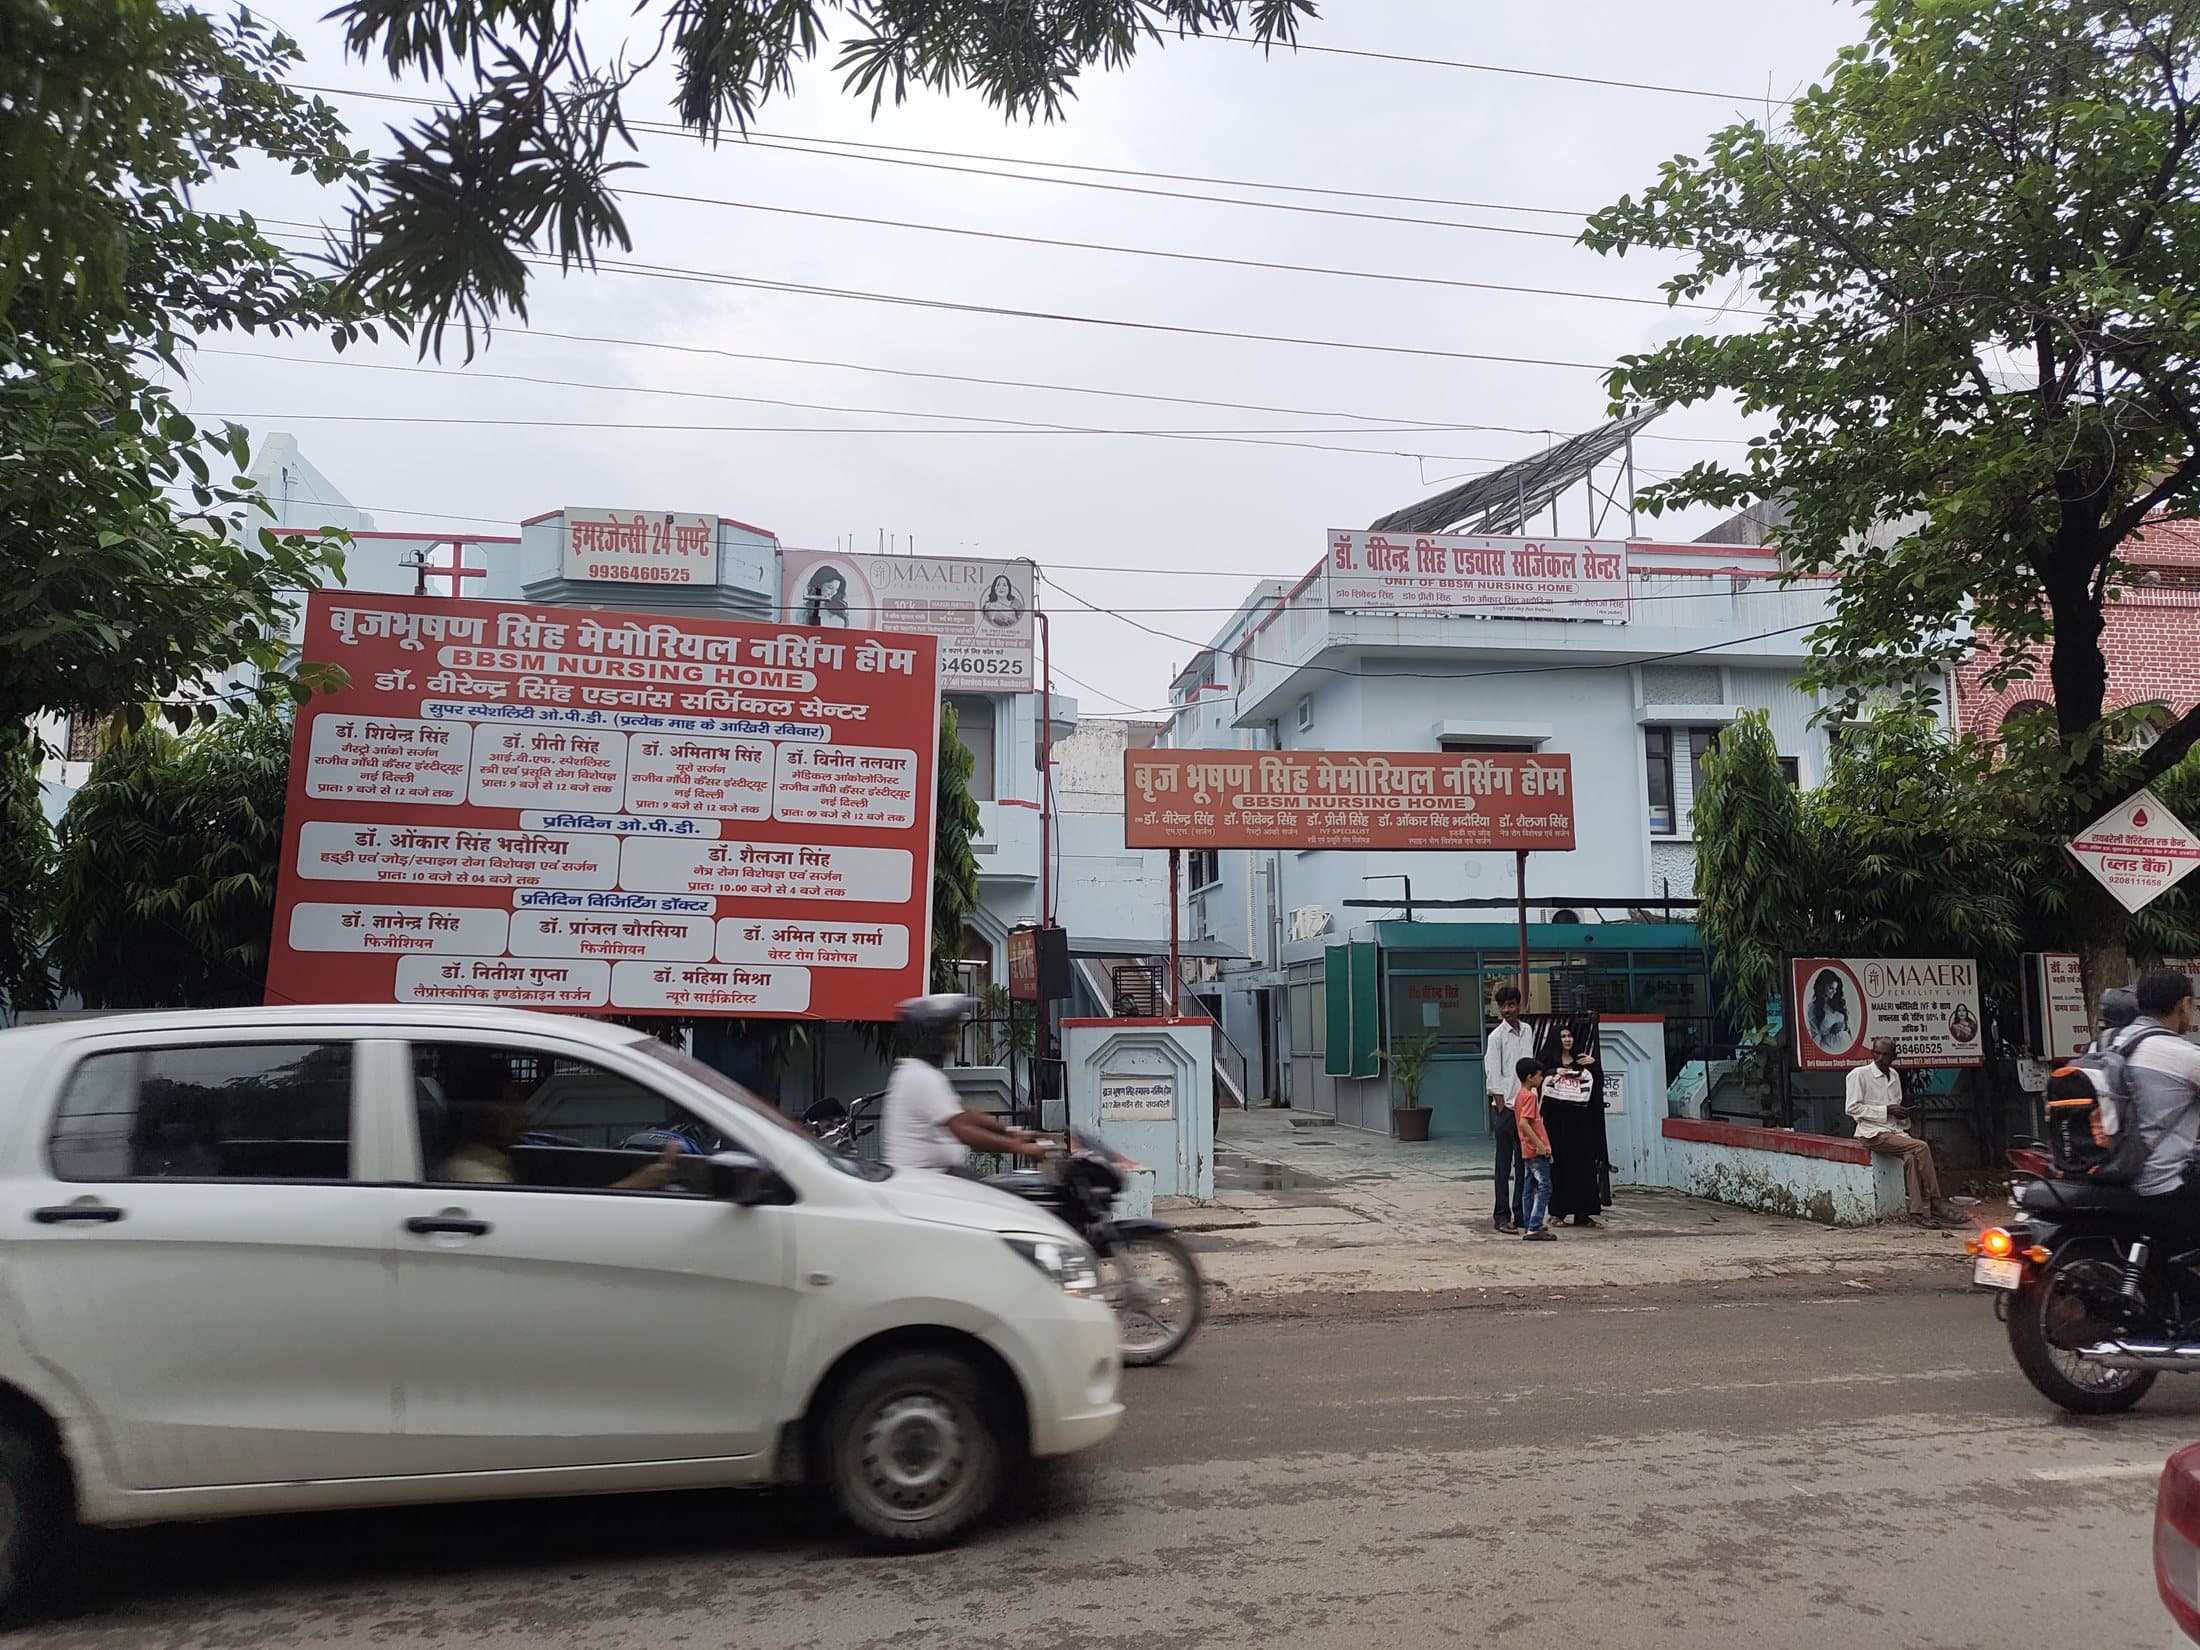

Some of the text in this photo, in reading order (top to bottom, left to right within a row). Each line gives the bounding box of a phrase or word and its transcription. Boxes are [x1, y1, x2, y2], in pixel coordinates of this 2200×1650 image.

[570, 513, 711, 557] इमरजेन्सी 24 घण्टे
[1333, 535, 1622, 580] डॉ. वीरेन्द्र सिंह एडवांस सर्जिकल सेन्टर
[589, 564, 690, 582] 9936460525
[893, 563, 984, 585] MAAERI
[1384, 577, 1573, 592] UNIT OF BBSM NURSING HOME
[329, 606, 917, 675] बृजभूषण सिंह मेमोरियल नर्सिंग होम
[452, 649, 803, 688] BBSM NURSING HOME
[374, 669, 870, 720] डॉ. वीरेन्द्र सिंह एडवांस सर्जिकल सेन्टर
[429, 703, 825, 739] सुपर स्पेशलिटी ओ.पी.डी. (प्रत्येक माह के आखिरी रविवार)
[335, 722, 449, 744] डॉ. शिवेन्द्र सिंह
[502, 732, 600, 754] डॉ. प्रीती सिंह
[641, 740, 762, 763] डॉ. अमिताभ सिंह
[787, 749, 907, 770] डॉ. विनीत तलवार
[1133, 756, 1567, 805] बृज भूषण सिंह मेमोरियल नर्सिंग होम
[1242, 796, 1466, 809] BBSM NURSING HOME
[542, 814, 701, 834] प्रतिदिन ओ.पी.डी.
[1143, 811, 1159, 825] डॉ.
[1162, 810, 1192, 827] वीरेन्द्र
[1194, 811, 1215, 826] सिंह
[1223, 811, 1239, 825] डॉ.
[1242, 810, 1275, 827] शिवेन्द्र
[1277, 811, 1298, 826] सिंह
[1306, 812, 1322, 826] डॉ.
[1324, 811, 1346, 827] प्रीती
[1349, 811, 1369, 827] सिंह
[1378, 812, 1393, 827] डॉ.
[1430, 812, 1449, 827] सिंह
[1452, 813, 1490, 827] भदौरिया
[1498, 813, 1513, 828] डॉ.
[1516, 814, 1547, 828] शैलजा
[1549, 813, 1569, 828] सिंह
[354, 828, 569, 856] डॉ. ओंकार सिंह भदौरिया
[2092, 833, 2124, 844] रायबरेली
[2125, 834, 2155, 846] चैरिटेबल
[2170, 837, 2187, 847] केन्द्र
[708, 844, 831, 867] डॉ. शैलजा सिंह
[2100, 855, 2173, 877] (ब्लड बैंक)
[520, 891, 711, 912] प्रतिदिन विजिटिंग डॉक्टर
[340, 911, 460, 932] डॉ. ज्ञानेन्द्र सिंह
[539, 916, 688, 939] डॉ. प्रांजल चौरसिया
[364, 934, 434, 950] फिजीशियन
[743, 924, 883, 946] डॉ. अमित राज शर्मा
[579, 941, 647, 956] फिजीशियन
[767, 949, 858, 964] चेस्ट रोग विशेषज्ञ
[440, 962, 568, 986] डॉ. नितीश गुप्ता
[653, 965, 772, 986] डॉ. महिमा मिश्रा
[1886, 964, 1972, 986] MAAERI
[2050, 962, 2065, 973] डॉ.
[413, 984, 489, 1000] लैप्रोस्कोपिक
[559, 988, 591, 1001] सर्जन
[665, 989, 689, 1005] न्यूरो
[1871, 1002, 1894, 1011] MAAERI
